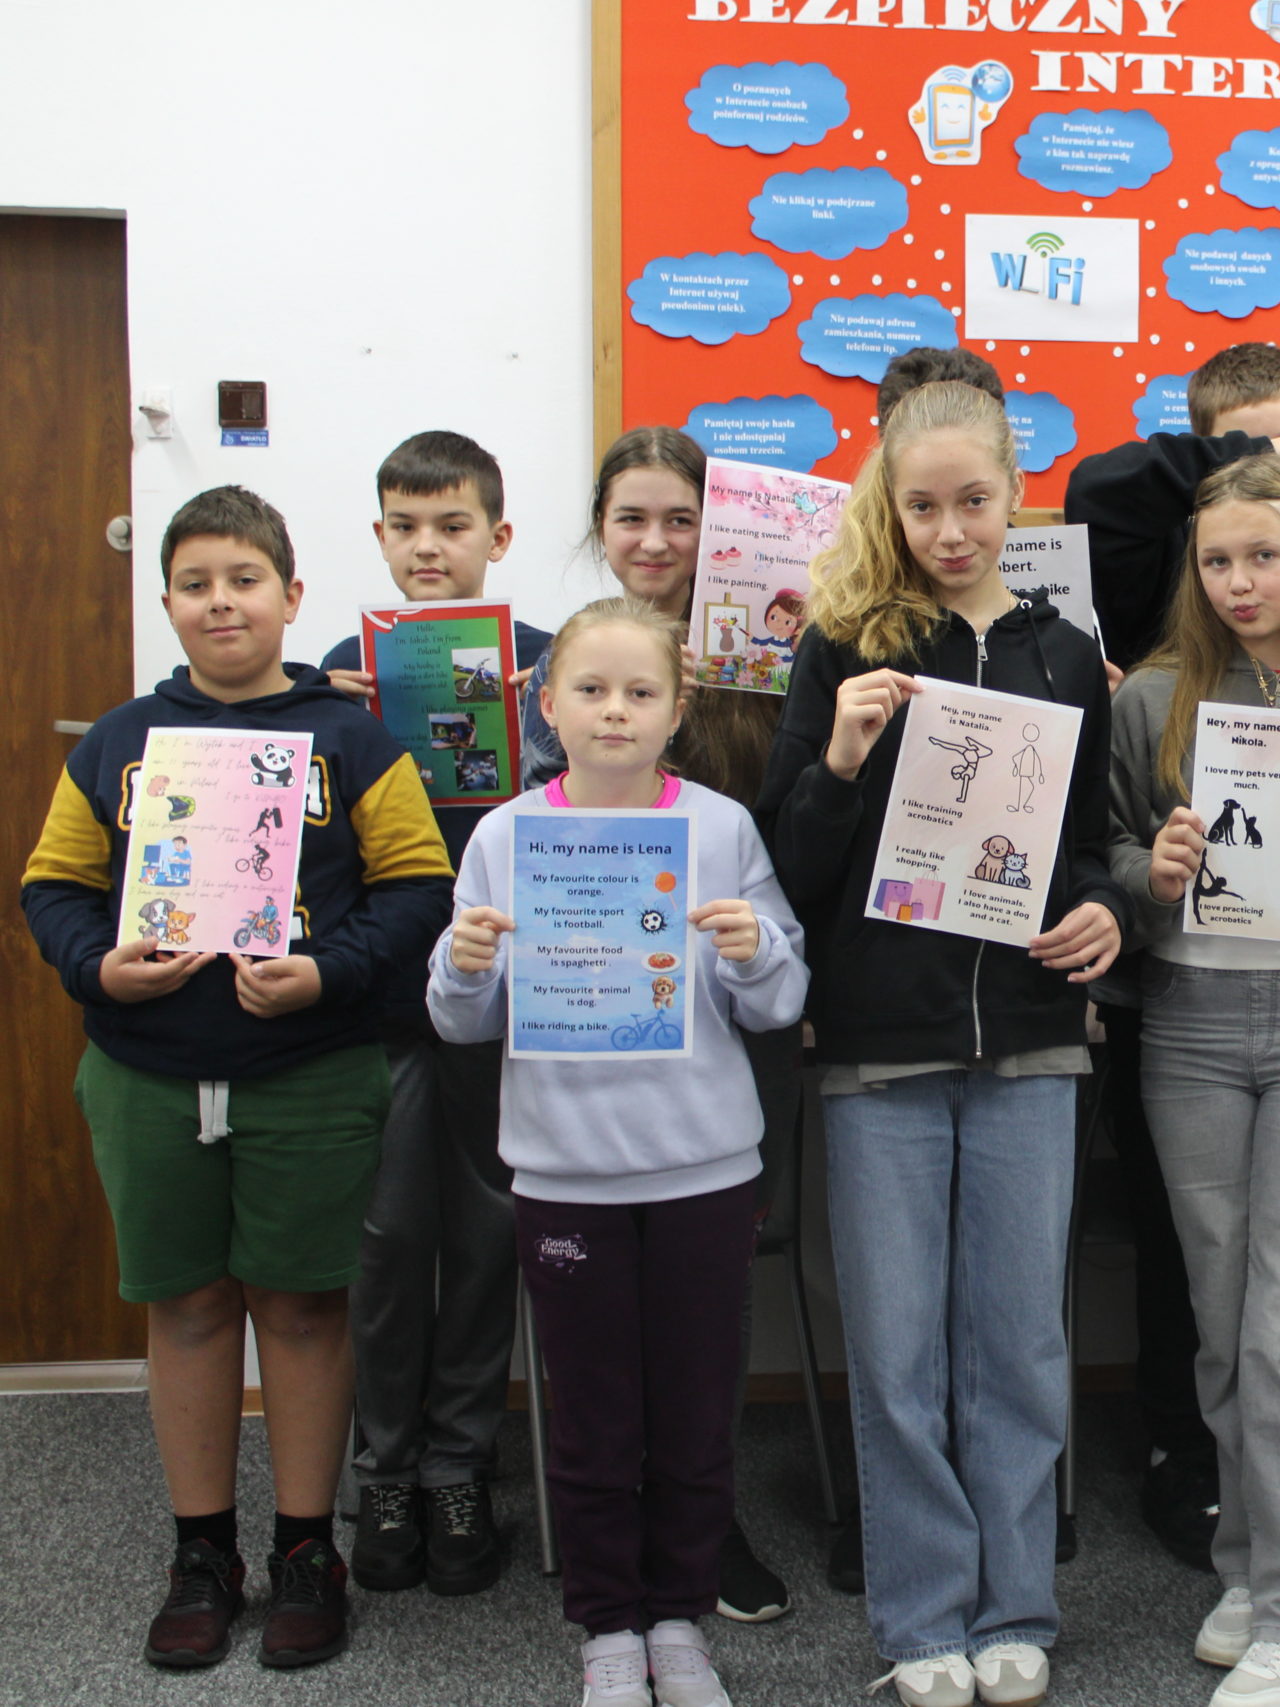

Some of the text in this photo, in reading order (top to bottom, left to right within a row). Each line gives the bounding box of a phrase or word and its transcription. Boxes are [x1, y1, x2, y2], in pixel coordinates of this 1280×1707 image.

[710, 484, 725, 498] My
[727, 488, 753, 501] name
[754, 490, 762, 500] is
[709, 523, 793, 542] I like eating sweets.
[1006, 538, 1062, 552] name is
[754, 553, 758, 561] I
[759, 553, 775, 563] like
[707, 575, 769, 591] I like painting.
[940, 704, 1002, 722] Hey, my name
[949, 716, 992, 732] is Natalia.
[1206, 717, 1230, 728] Hey,
[1233, 721, 1251, 731] my
[1231, 734, 1267, 747] Nikola.
[1204, 765, 1208, 773] I
[1209, 766, 1228, 774] love
[1230, 769, 1244, 777] my
[1245, 770, 1266, 778] pets
[1233, 782, 1260, 790] much.
[907, 799, 924, 809] like
[926, 804, 963, 818] training
[907, 811, 953, 826] acrobatics
[529, 841, 672, 857] Hi, my name is Lena
[901, 847, 927, 858] really
[929, 851, 945, 861] like
[895, 856, 941, 872] shopping.
[532, 873, 639, 884] My favourite colour is
[566, 888, 605, 897] orange.
[968, 889, 986, 899] love
[988, 895, 1026, 907] animals.
[534, 906, 624, 918] My favourite sport
[963, 899, 981, 908] also
[983, 903, 1003, 913] have
[1012, 910, 1030, 920] dog
[553, 919, 605, 928] is football.
[969, 912, 987, 920] and
[996, 917, 1012, 925] cat.
[522, 1021, 525, 1029] I
[527, 1021, 545, 1030] like
[547, 1022, 576, 1032] riding
[586, 1022, 610, 1031] bike.
